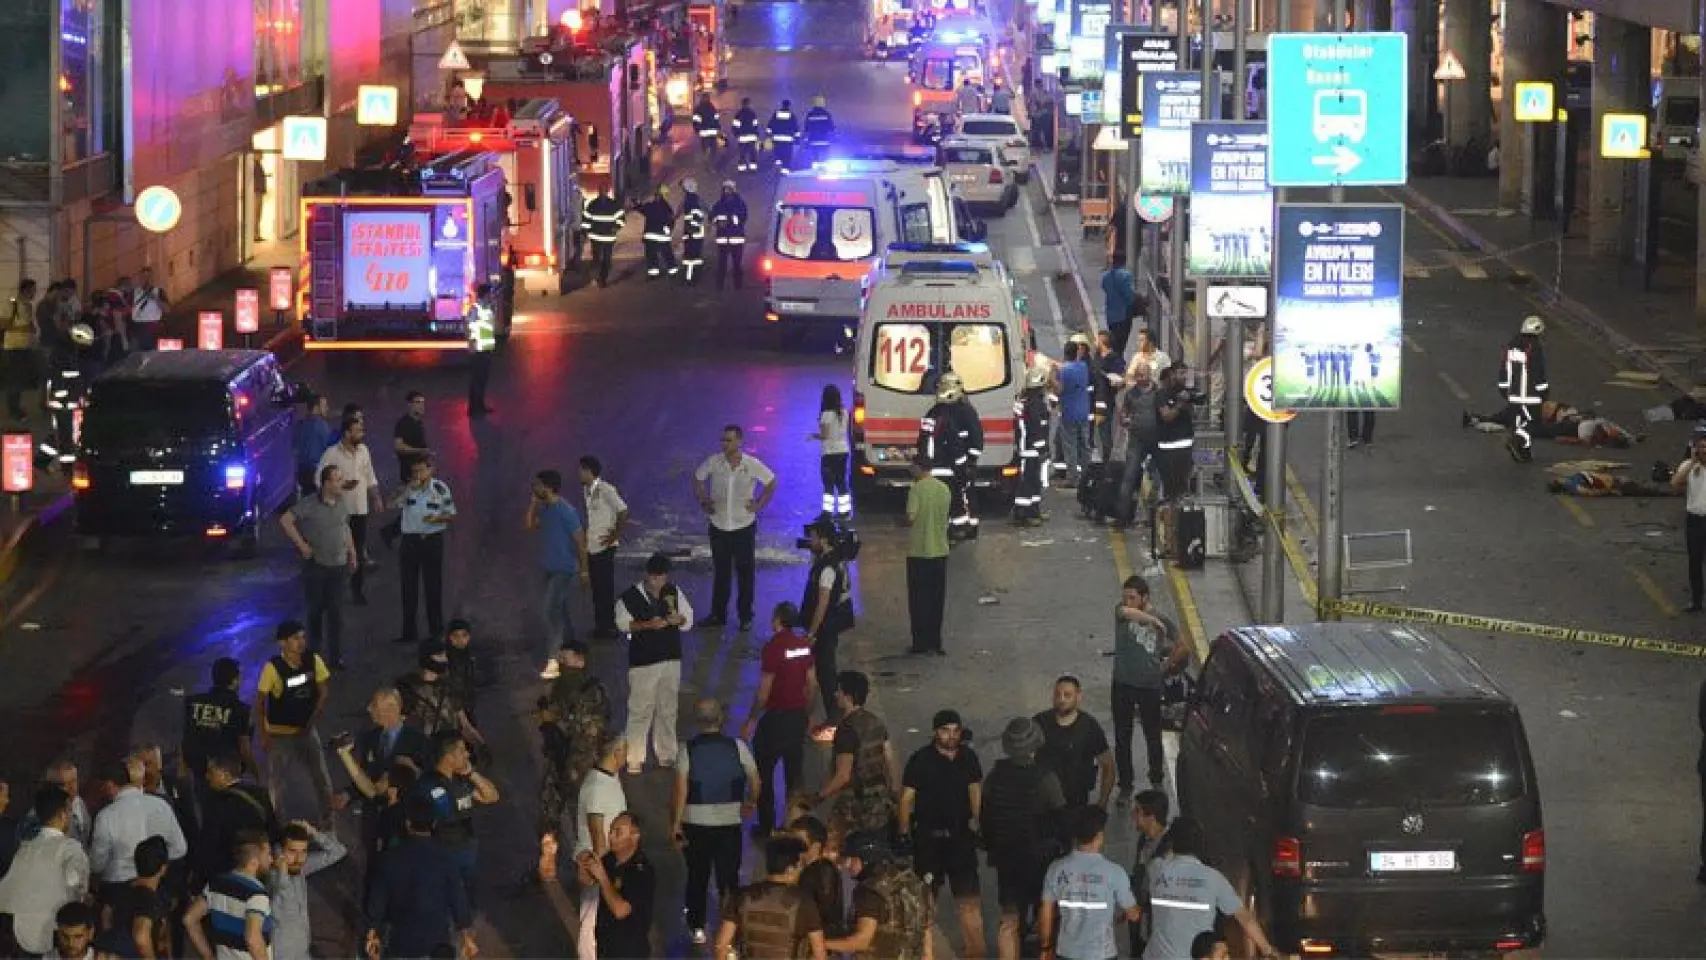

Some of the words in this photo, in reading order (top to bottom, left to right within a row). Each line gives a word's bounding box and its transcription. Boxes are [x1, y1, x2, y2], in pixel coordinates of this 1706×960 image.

[1304, 261, 1323, 283] EN
[886, 303, 992, 319] AMBULANS
[879, 336, 927, 374] 112
